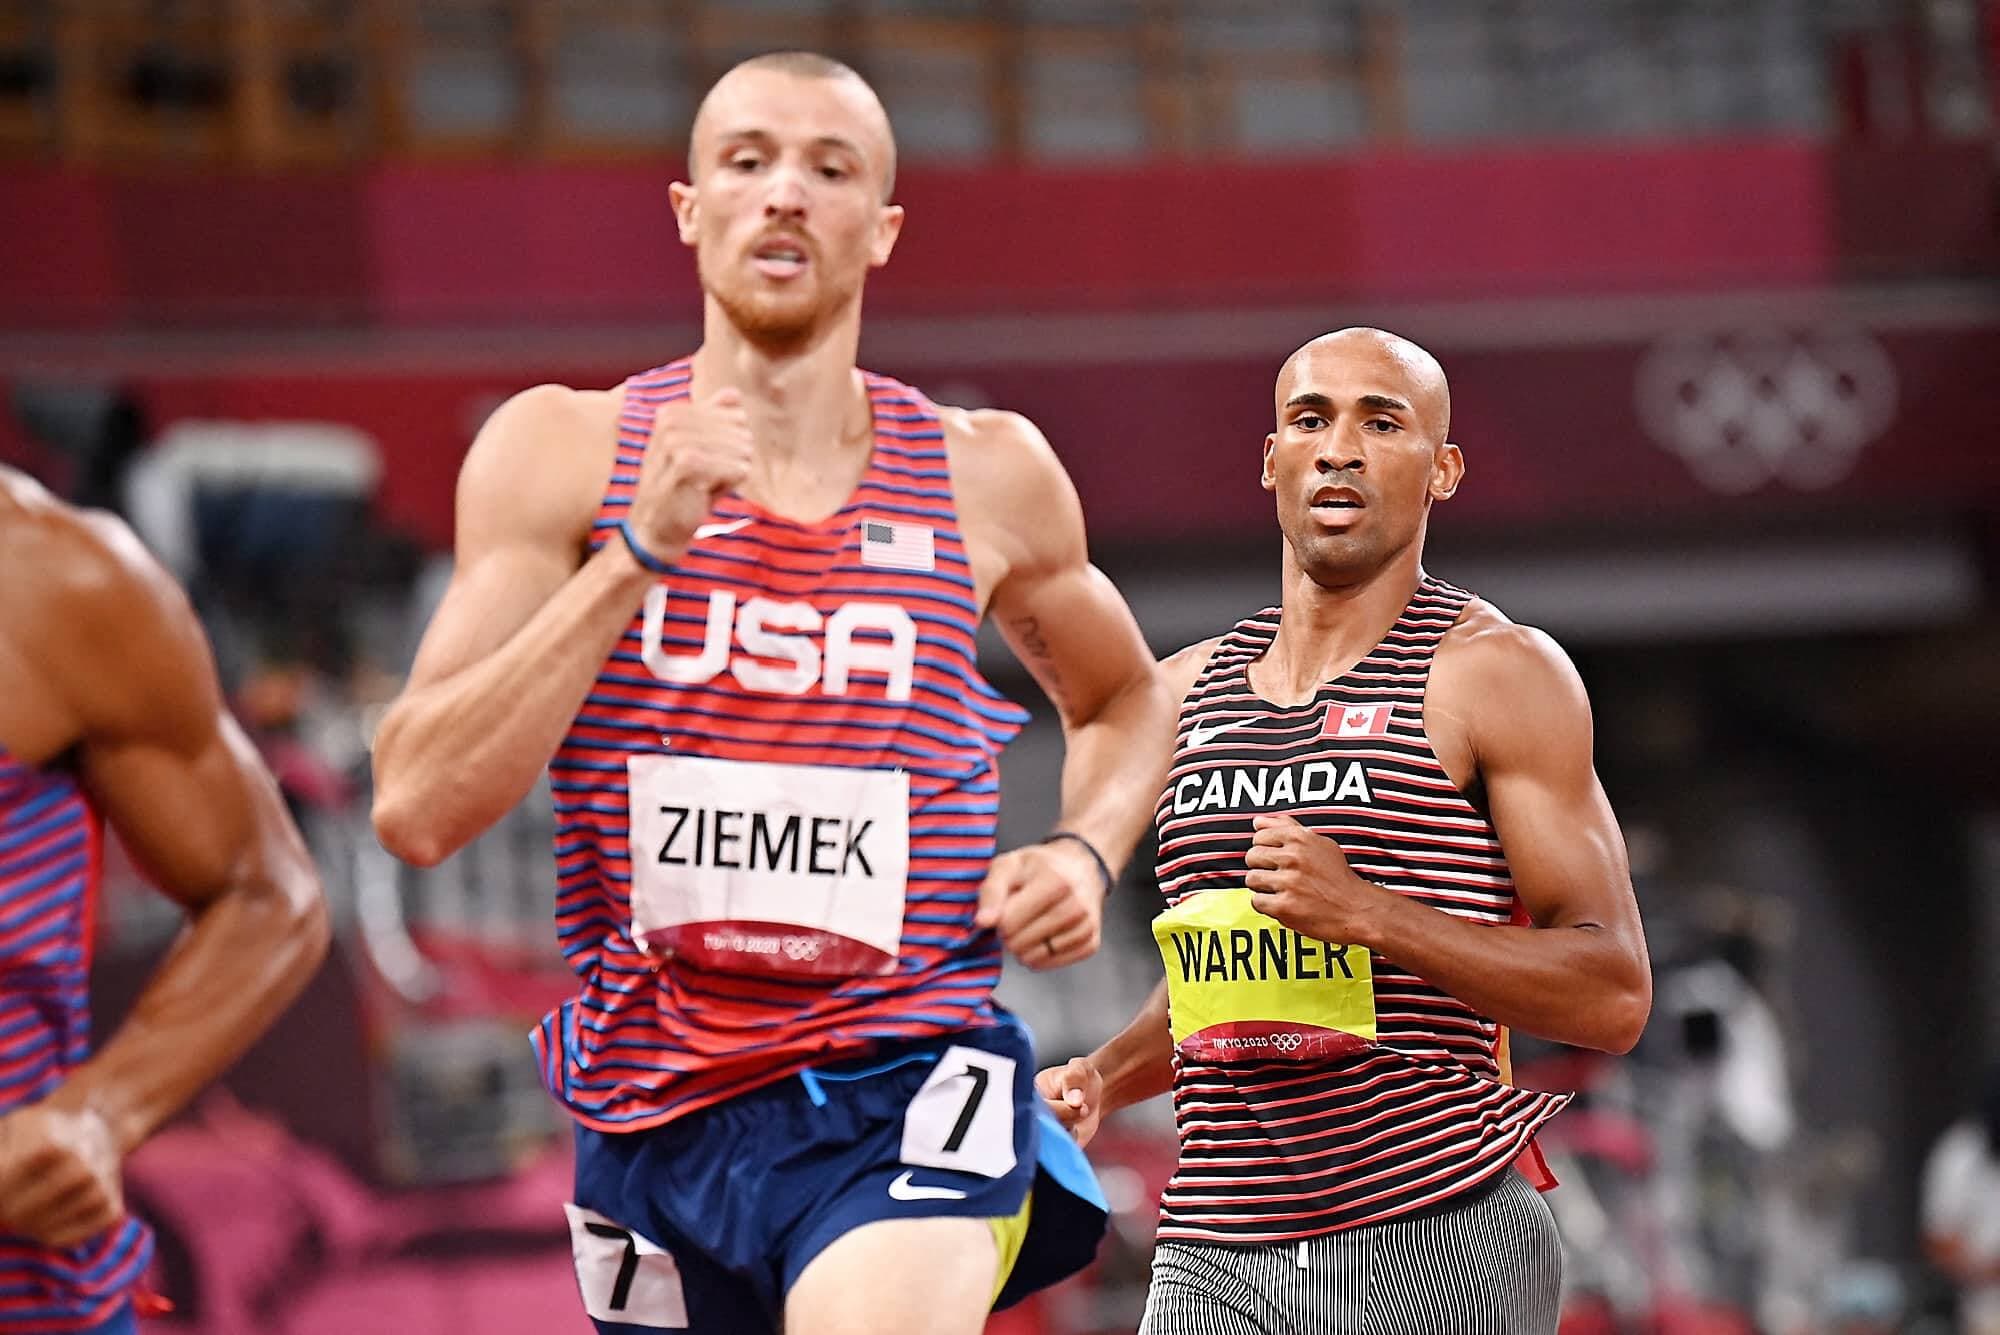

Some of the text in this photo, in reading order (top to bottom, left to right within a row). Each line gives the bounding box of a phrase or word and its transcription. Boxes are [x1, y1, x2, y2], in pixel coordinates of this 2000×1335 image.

[642, 584, 918, 701] USA
[1173, 761, 1372, 815] CANADA
[657, 806, 874, 877] ZIEMEK
[1171, 928, 1353, 982] WARNER
[1212, 1037, 1268, 1049] TOKYO 2020
[585, 1221, 641, 1311] 7
